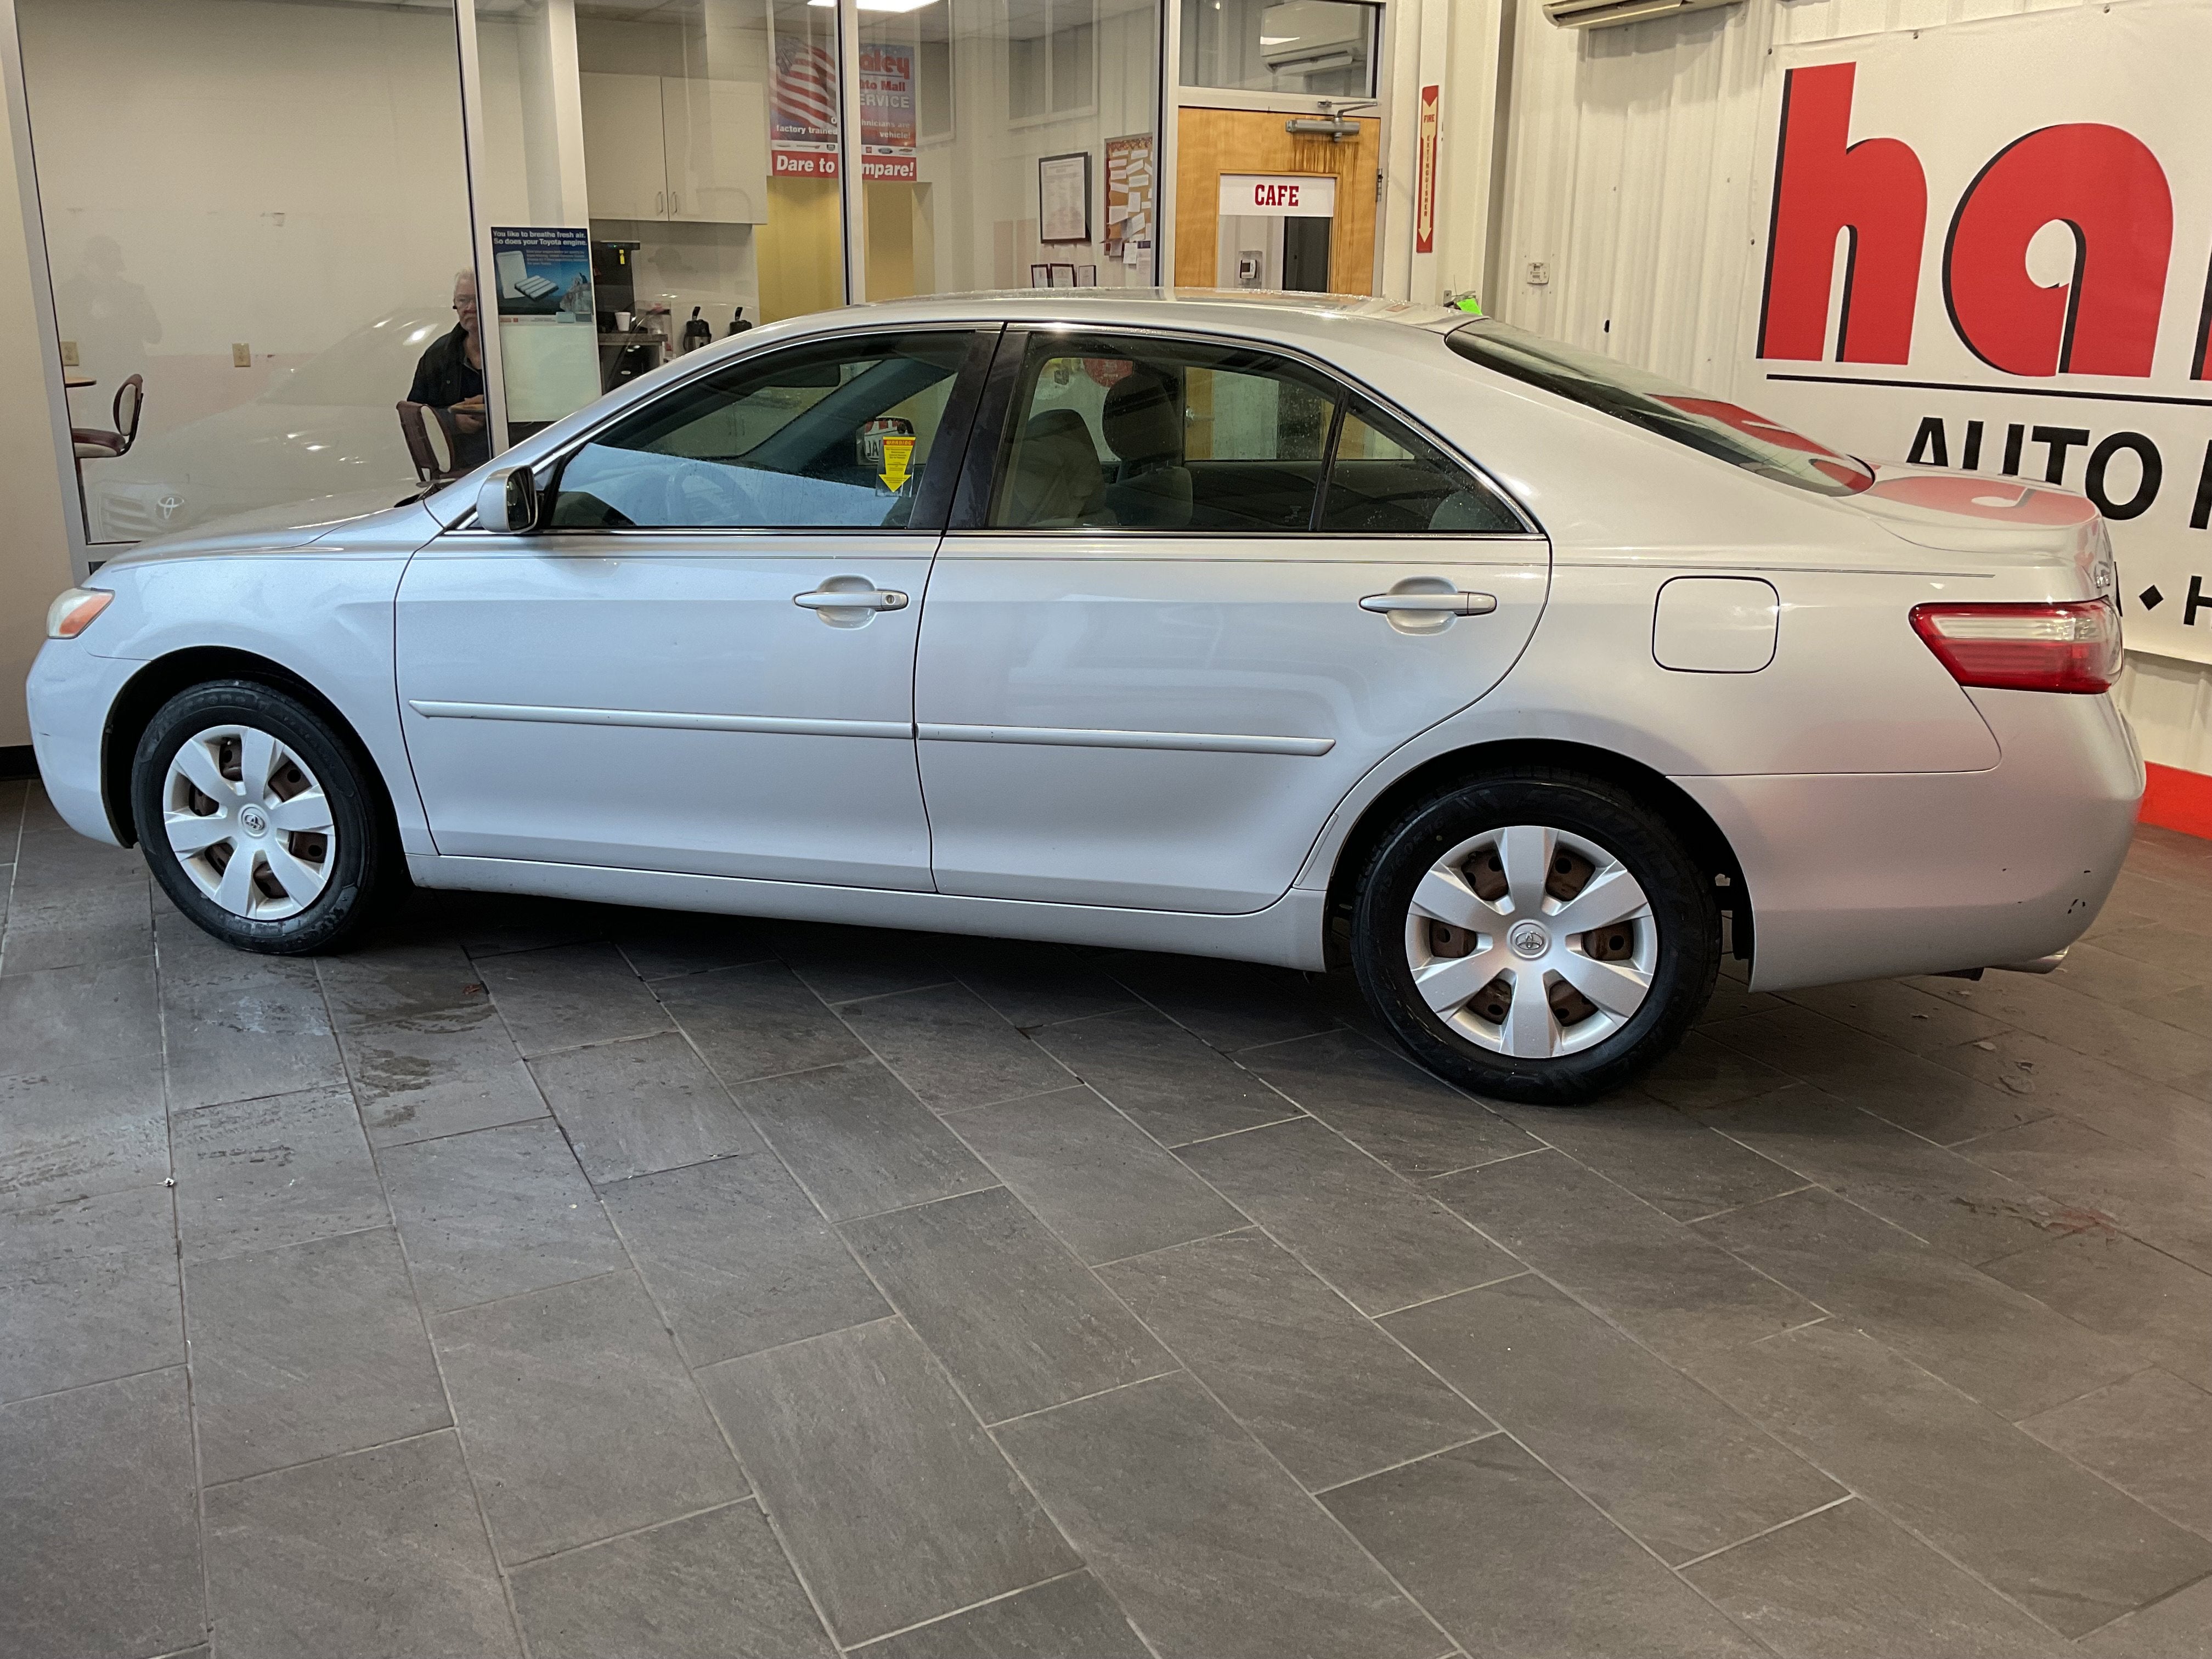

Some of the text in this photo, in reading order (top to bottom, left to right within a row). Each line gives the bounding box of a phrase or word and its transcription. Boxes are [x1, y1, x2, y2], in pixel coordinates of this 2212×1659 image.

[860, 50, 910, 80] aley
[860, 80, 905, 92] uto Mall
[860, 94, 910, 108] ERVICE
[861, 119, 895, 128] hnicians
[1424, 114, 1435, 123] FIRE
[776, 125, 806, 134] factory
[808, 126, 837, 135] trained
[777, 155, 914, 178] Dare to mpare!
[1255, 184, 1300, 206] CAFE
[1756, 61, 2212, 381] ha
[1906, 417, 2163, 521] AUTO
